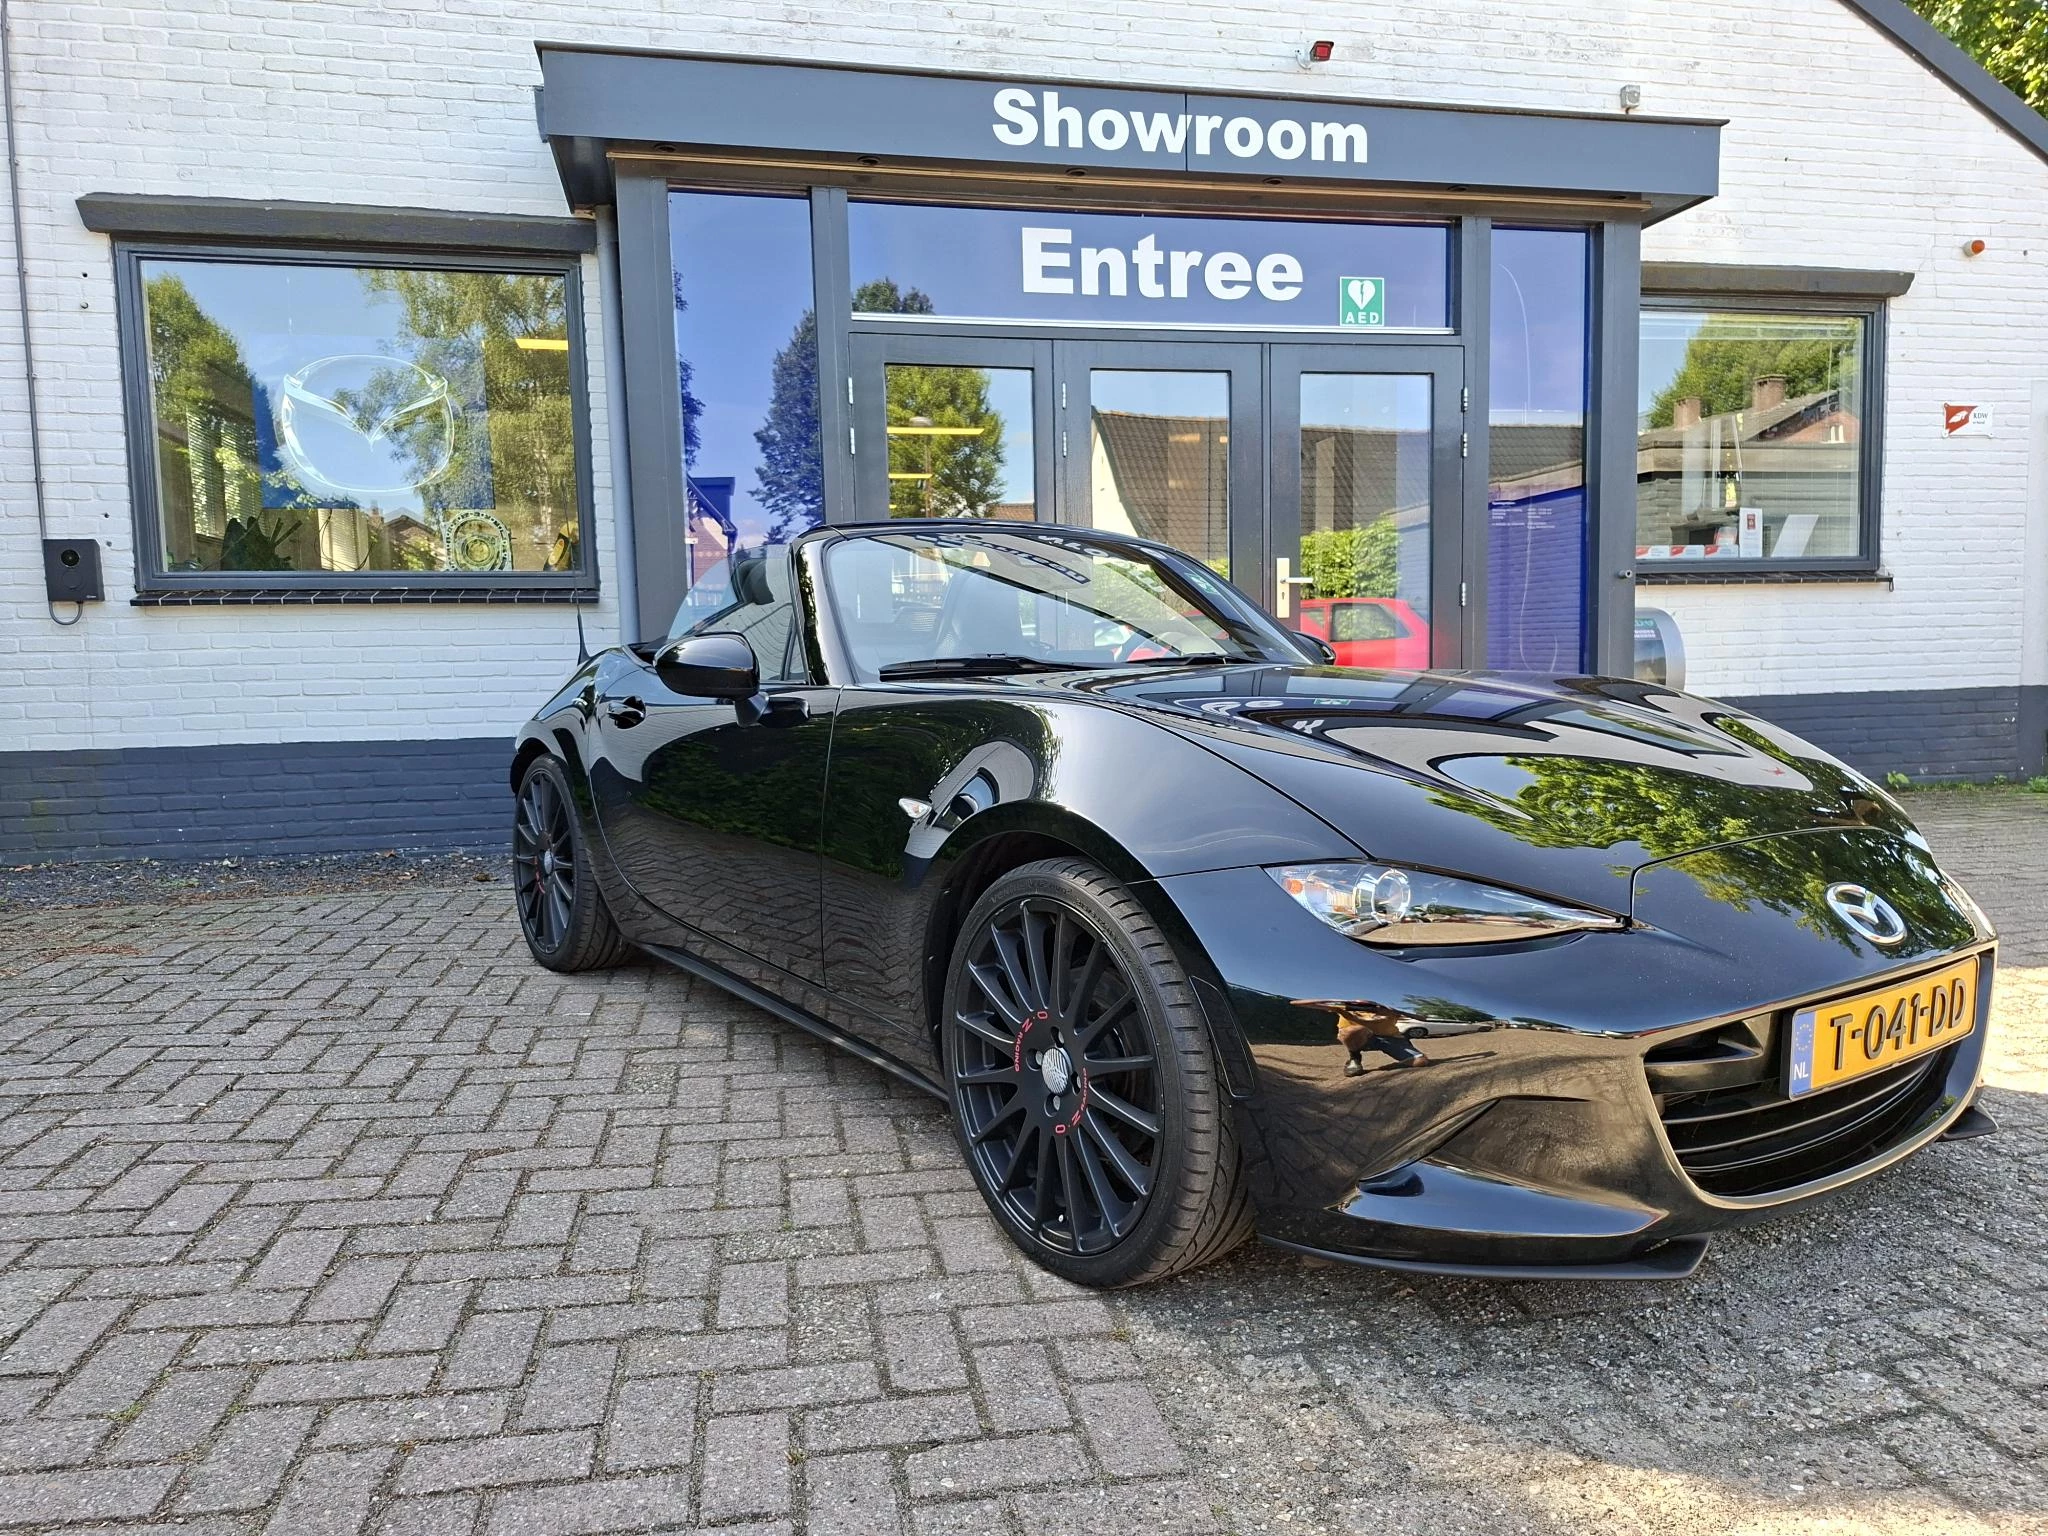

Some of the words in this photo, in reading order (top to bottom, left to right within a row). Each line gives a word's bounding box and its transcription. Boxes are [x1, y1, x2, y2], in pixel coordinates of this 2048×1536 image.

[992, 88, 1368, 164] Showroom
[1021, 227, 1304, 302] Entree
[1345, 311, 1380, 324] AED
[1830, 978, 1967, 1071] T-041-DD
[1793, 1061, 1809, 1081] NL
